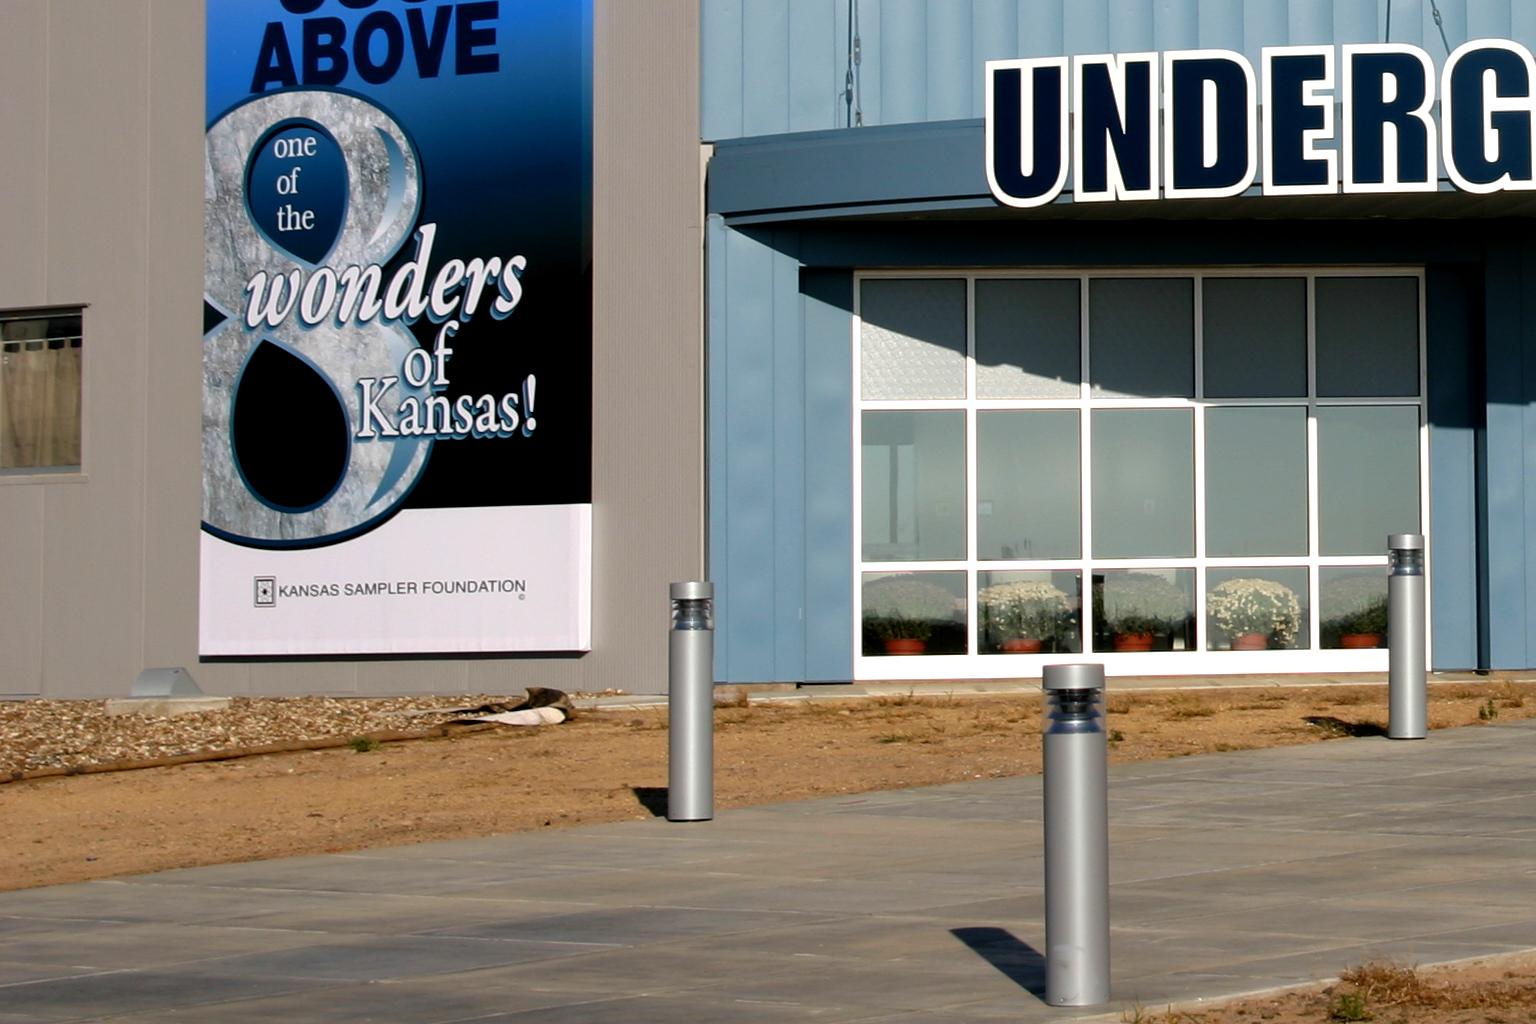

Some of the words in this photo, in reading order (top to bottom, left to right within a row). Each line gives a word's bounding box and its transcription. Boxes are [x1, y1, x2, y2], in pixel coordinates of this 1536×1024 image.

[250, 0, 500, 94] ABOVE
[274, 136, 318, 159] one
[276, 167, 301, 196] of
[276, 204, 315, 232] the
[246, 223, 527, 328] wonders
[403, 320, 459, 389] of
[356, 374, 537, 439] Kansas!
[278, 584, 340, 598] KANSAS
[344, 582, 418, 596] SAMPLER
[422, 579, 527, 594] FOUNDATION
